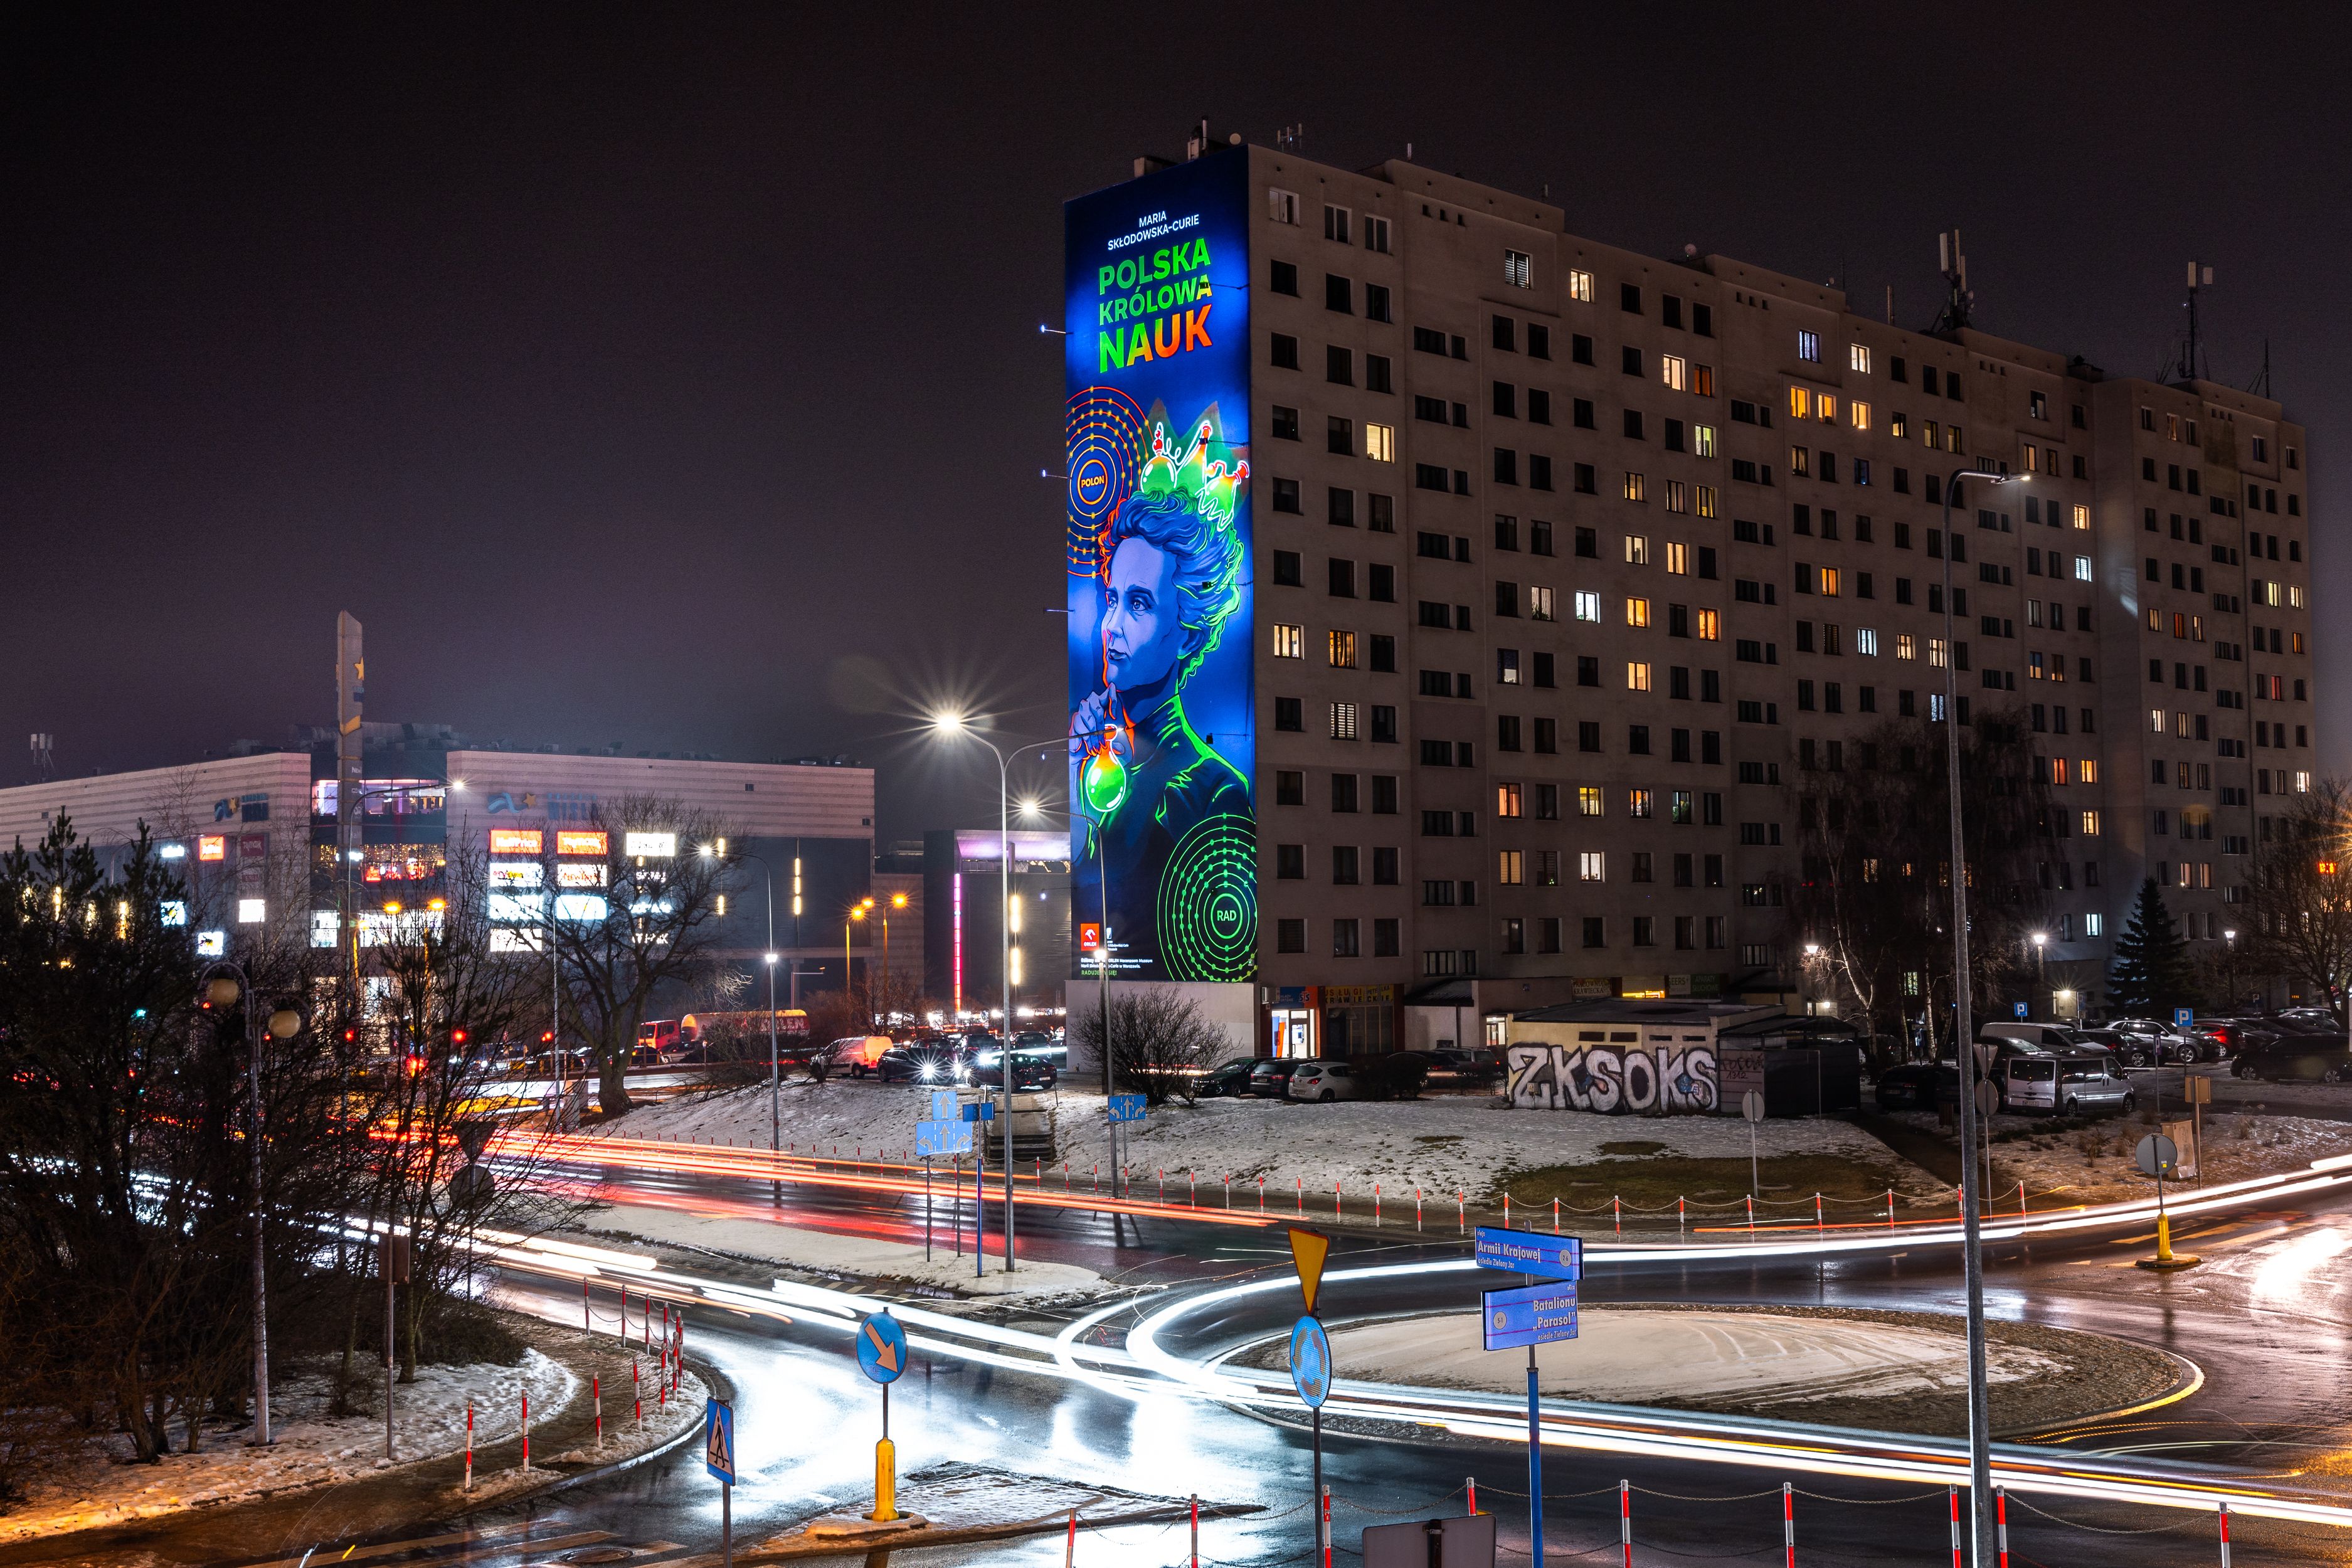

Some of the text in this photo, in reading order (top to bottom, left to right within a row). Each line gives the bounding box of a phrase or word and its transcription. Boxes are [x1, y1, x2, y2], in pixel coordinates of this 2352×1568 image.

[1139, 211, 1167, 228] MARIA
[1108, 214, 1199, 250] SKŁODOWSKA-CURIE
[1099, 238, 1211, 295] POLSKA
[1099, 273, 1212, 326] KRÓLOWA
[1099, 304, 1212, 374] NAUK
[1081, 475, 1104, 488] POLON
[1217, 910, 1236, 921] RAD
[1298, 991, 1310, 1003] STS
[2017, 1004, 2025, 1015] P
[2178, 1010, 2189, 1025] P
[1508, 1042, 1717, 1112] ZKSOKS
[1726, 1070, 1748, 1079] 1312
[1478, 1240, 1541, 1264] Armii Krajowej
[1493, 1258, 1507, 1268] Zielony
[1533, 1296, 1576, 1313] Batalionu
[1532, 1311, 1576, 1332] „Parasol”
[1538, 1332, 1553, 1340] osiedle
[1554, 1329, 1569, 1338] Zielony
